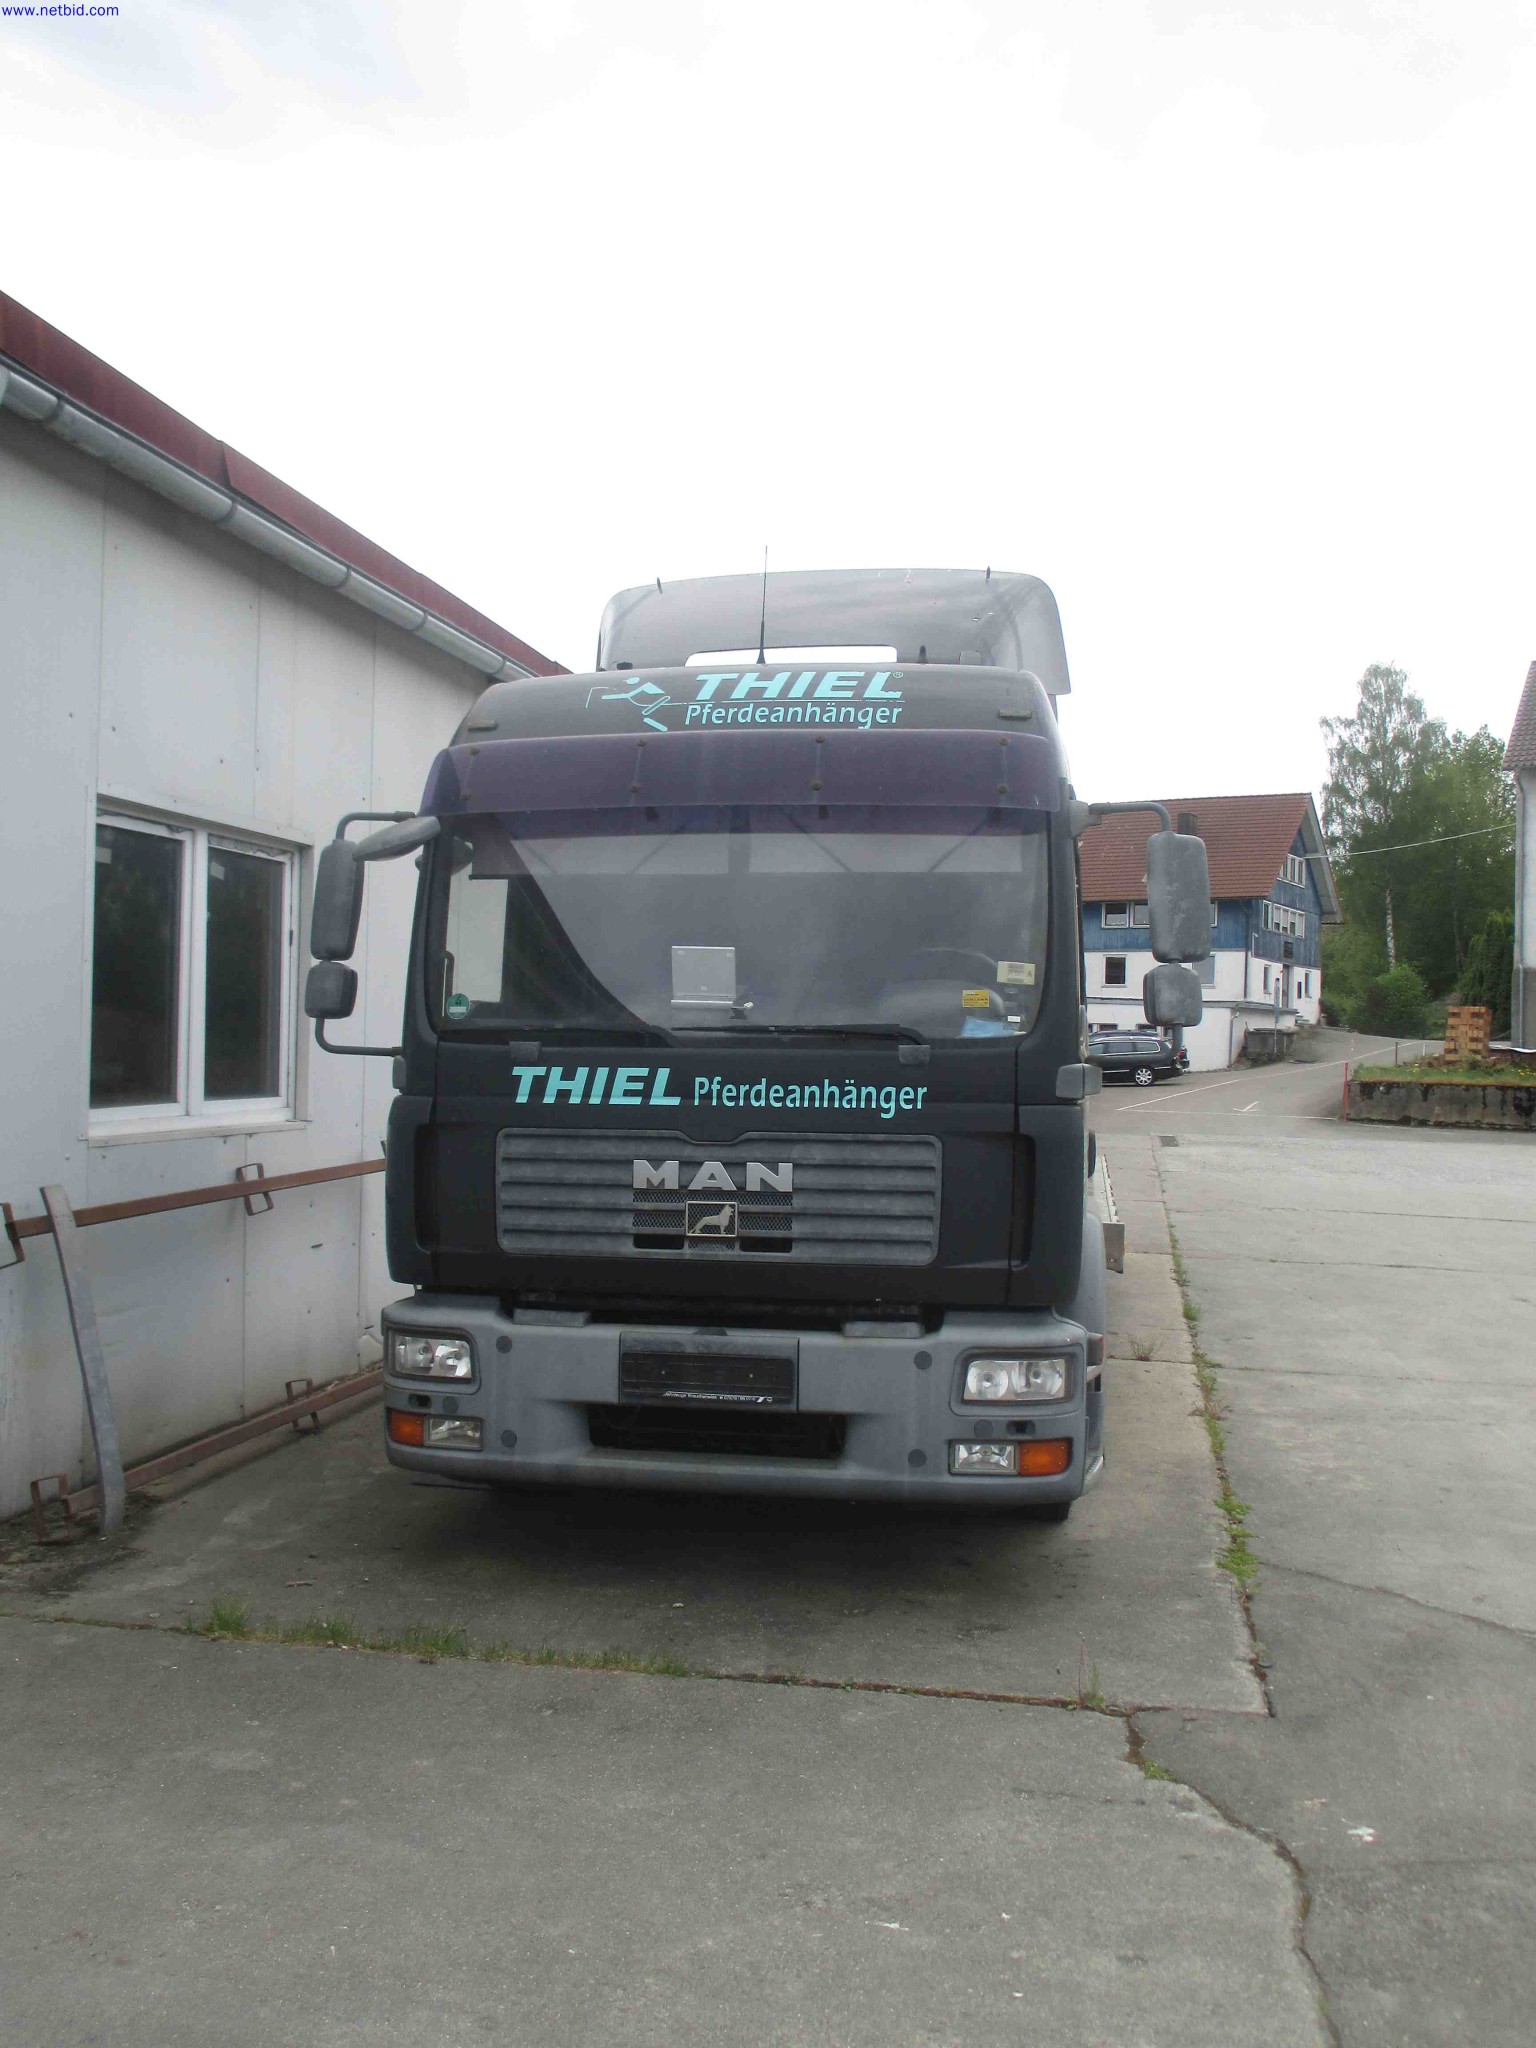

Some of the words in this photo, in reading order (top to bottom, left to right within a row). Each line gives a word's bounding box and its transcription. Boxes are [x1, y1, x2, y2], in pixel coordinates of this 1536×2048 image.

[695, 671, 902, 700] THIEL
[684, 702, 902, 729] Pferdeanhänger
[511, 1066, 682, 1106] THIEL
[694, 1077, 928, 1119] Pferdeanhänger
[632, 1160, 793, 1193] MAN
